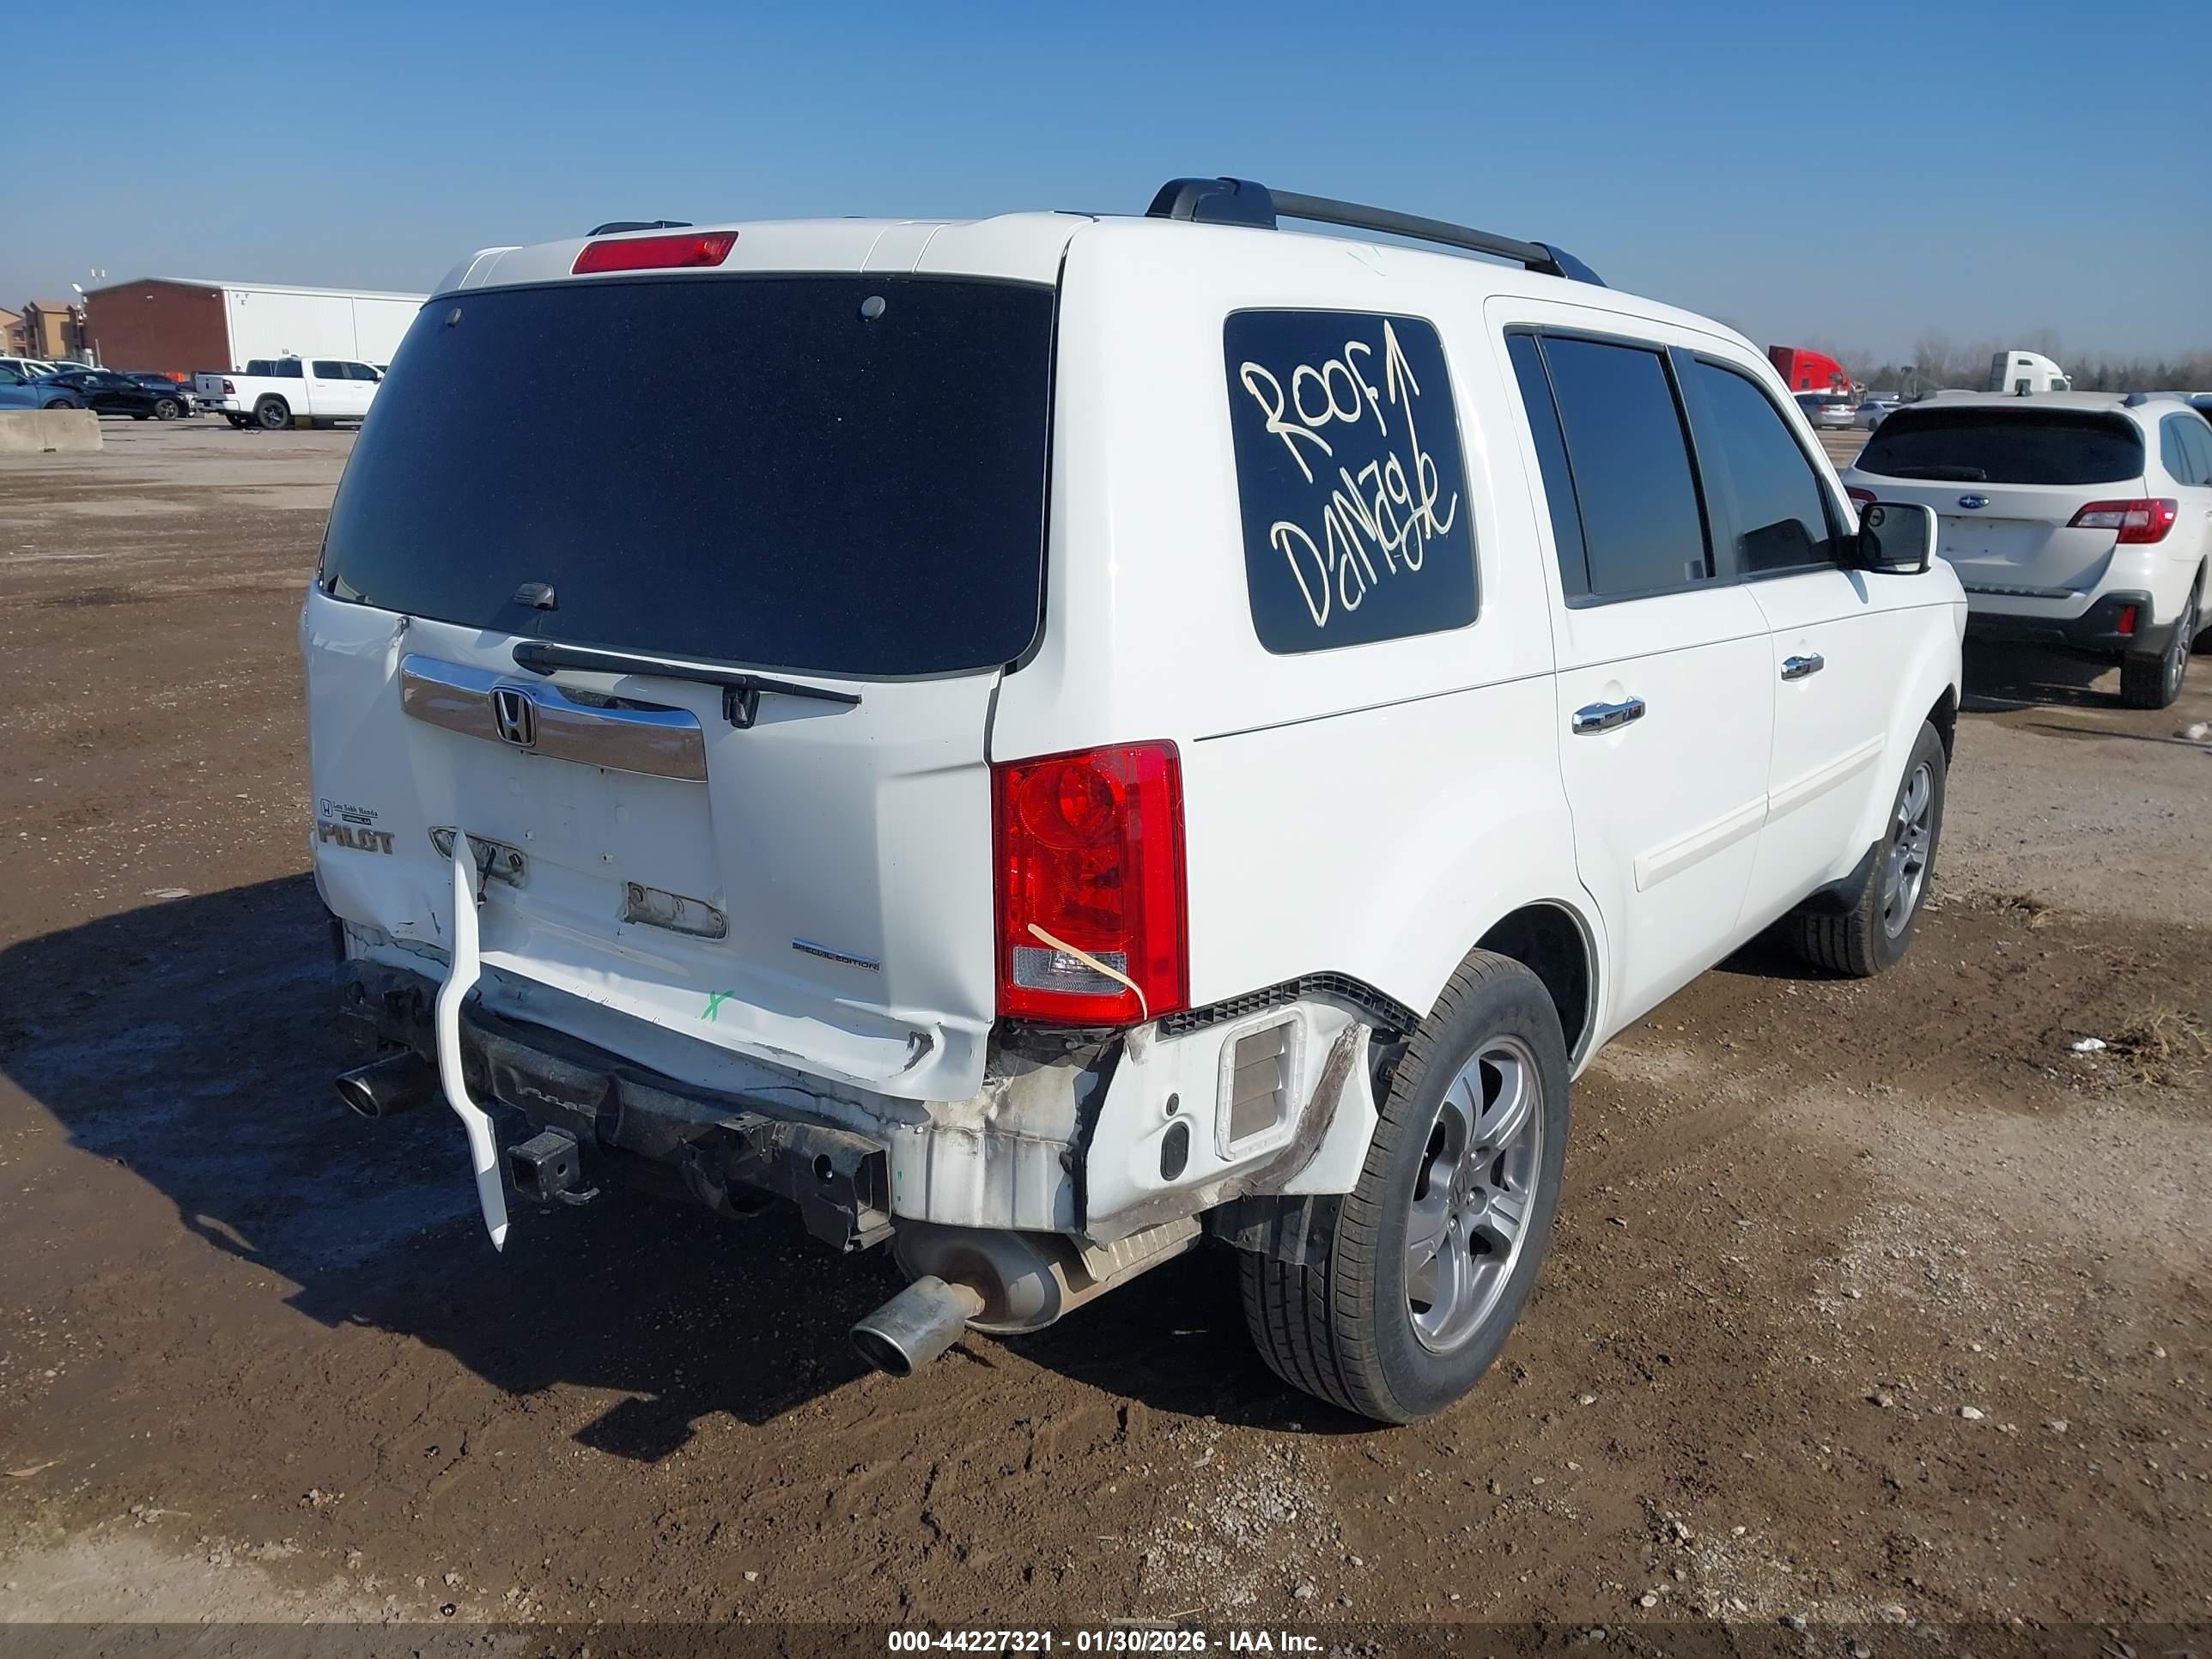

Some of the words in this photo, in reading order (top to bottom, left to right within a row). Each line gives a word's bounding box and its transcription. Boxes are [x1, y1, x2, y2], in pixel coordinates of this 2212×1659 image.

[317, 819, 395, 854] PILOT
[792, 942, 833, 960] SPECIAL
[836, 955, 880, 971] EDITION
